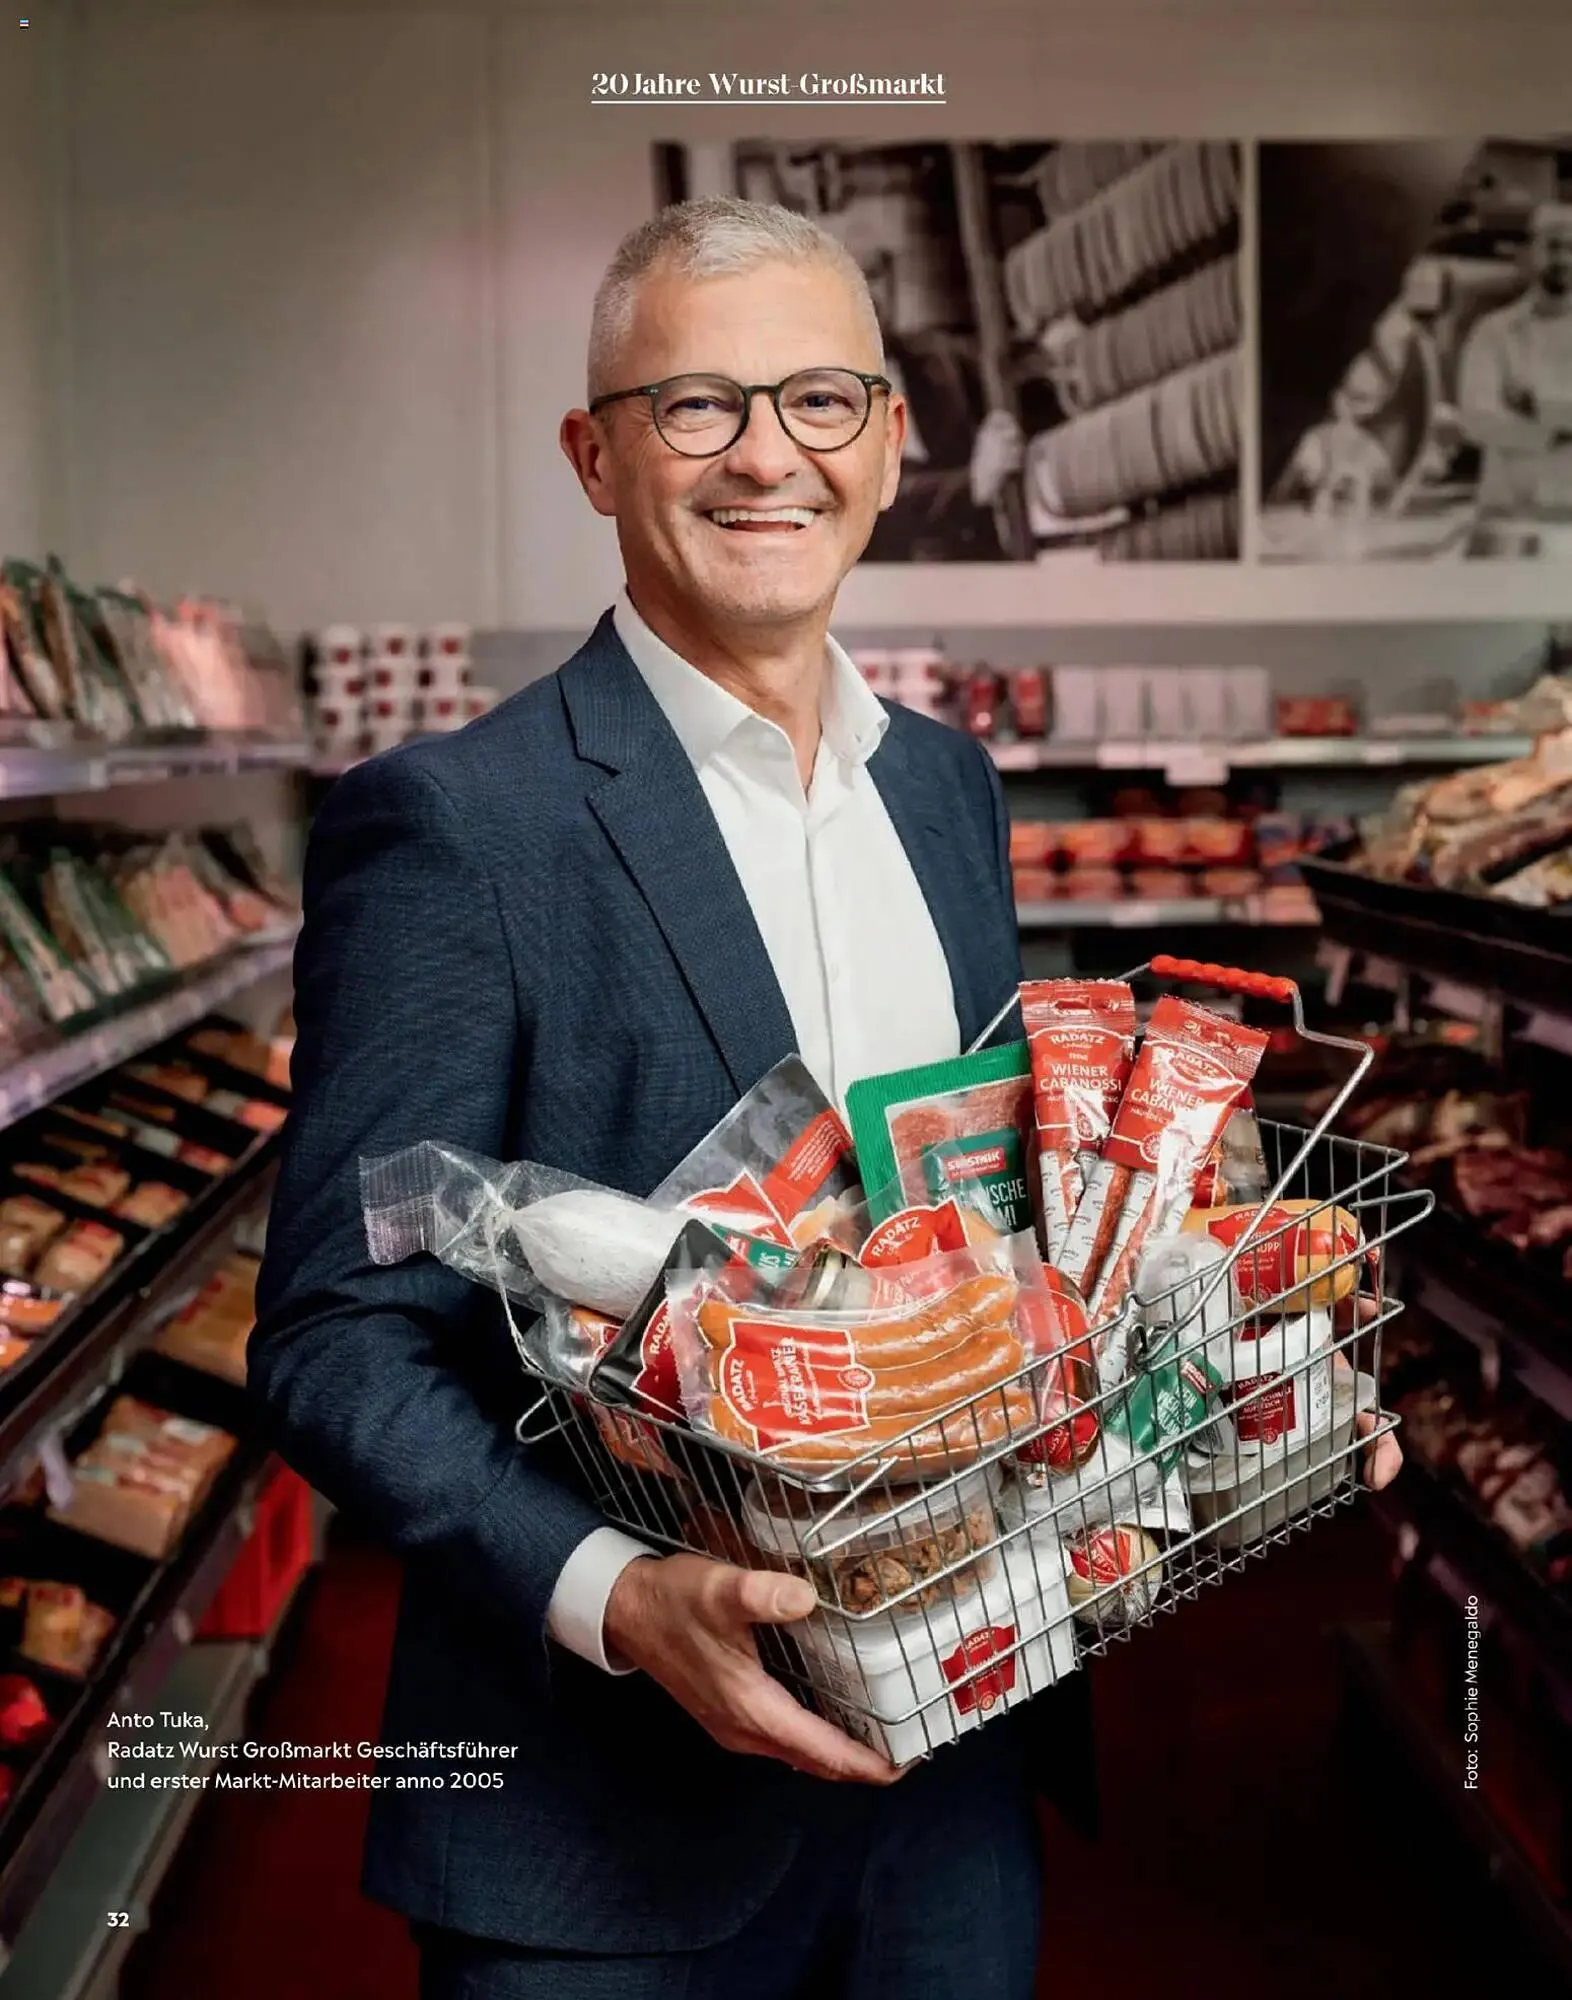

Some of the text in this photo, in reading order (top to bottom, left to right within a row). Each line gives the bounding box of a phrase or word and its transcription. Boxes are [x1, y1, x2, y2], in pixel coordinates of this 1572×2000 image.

[1050, 1032, 1105, 1045] RADATZ
[1051, 1063, 1109, 1077] WIENER
[1040, 1077, 1122, 1092] CABANOSSI
[871, 1216, 921, 1257] RADATZ
[729, 1358, 756, 1413] RADATZ
